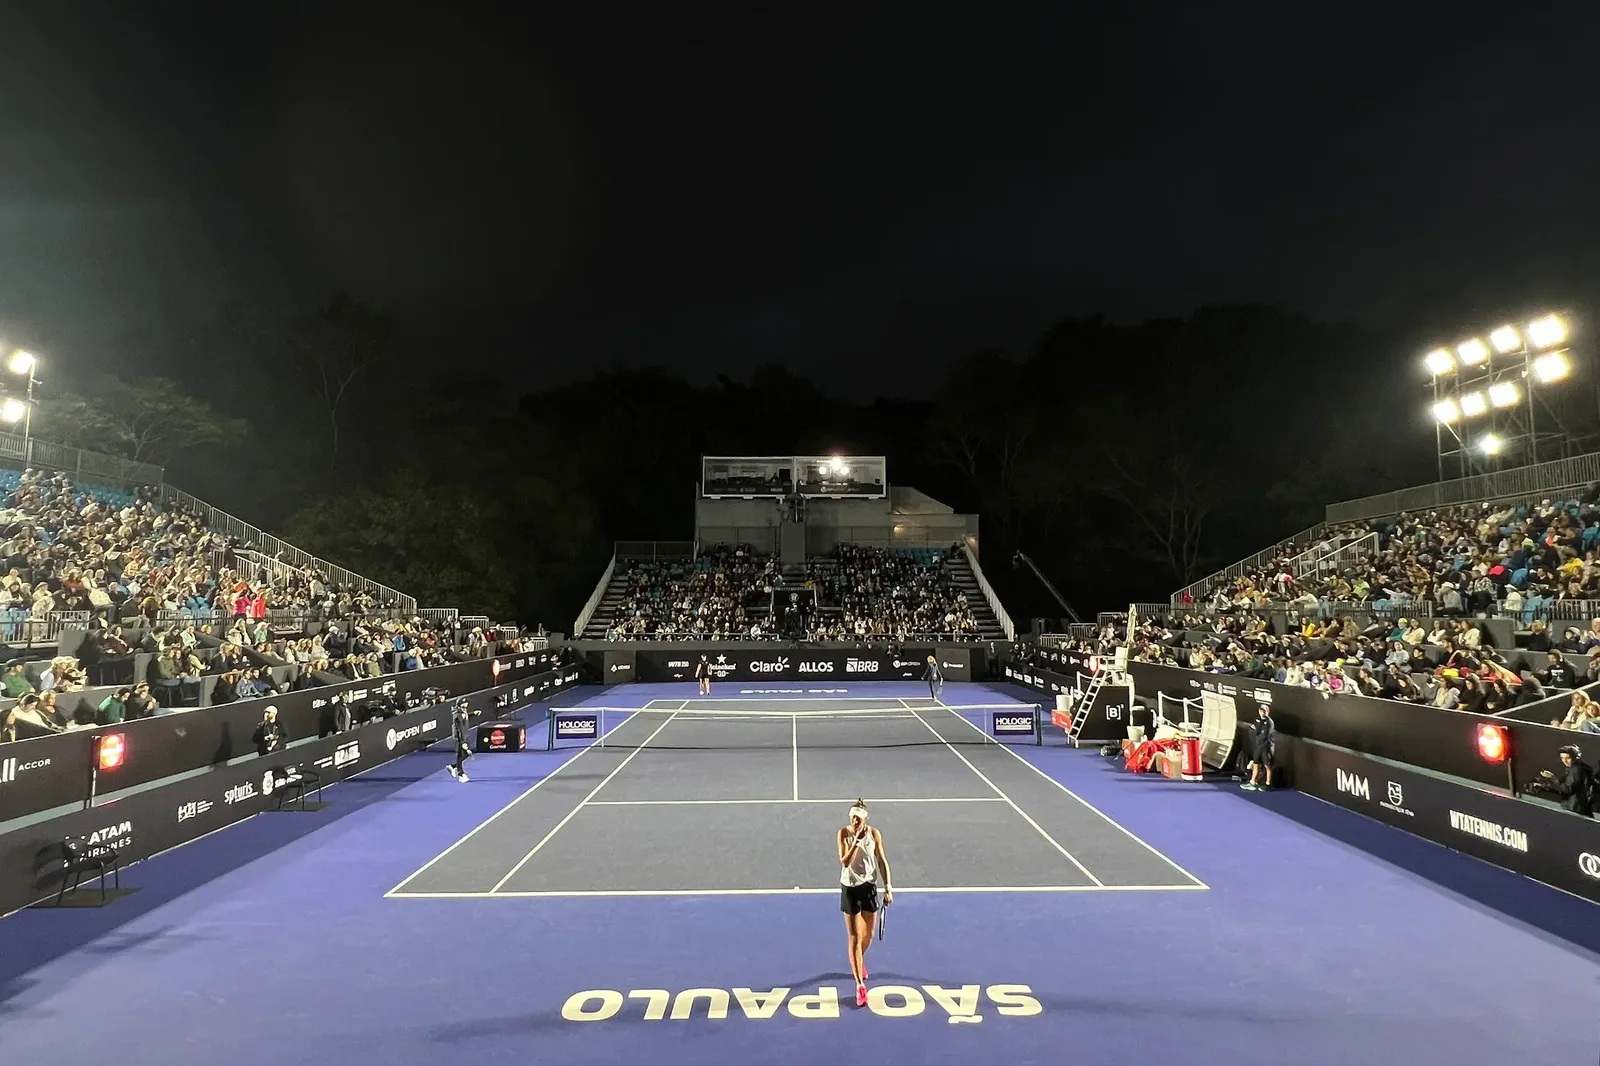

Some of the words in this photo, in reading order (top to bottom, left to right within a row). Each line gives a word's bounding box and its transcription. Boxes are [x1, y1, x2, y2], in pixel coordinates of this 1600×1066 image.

[750, 659, 785, 673] Claro
[798, 661, 834, 673] ALLOS
[857, 661, 880, 673] BRB
[558, 720, 596, 729] HOLOGIC
[995, 717, 1032, 725] HOLOGIC
[18, 758, 51, 772] ACCOR
[224, 781, 254, 805] spturis
[1336, 767, 1370, 801] IMM
[81, 820, 132, 846] ATAM
[1449, 809, 1528, 853] WTATENNIS.COM
[561, 987, 841, 1021] PAULO
[867, 985, 1043, 1024] SÃO
